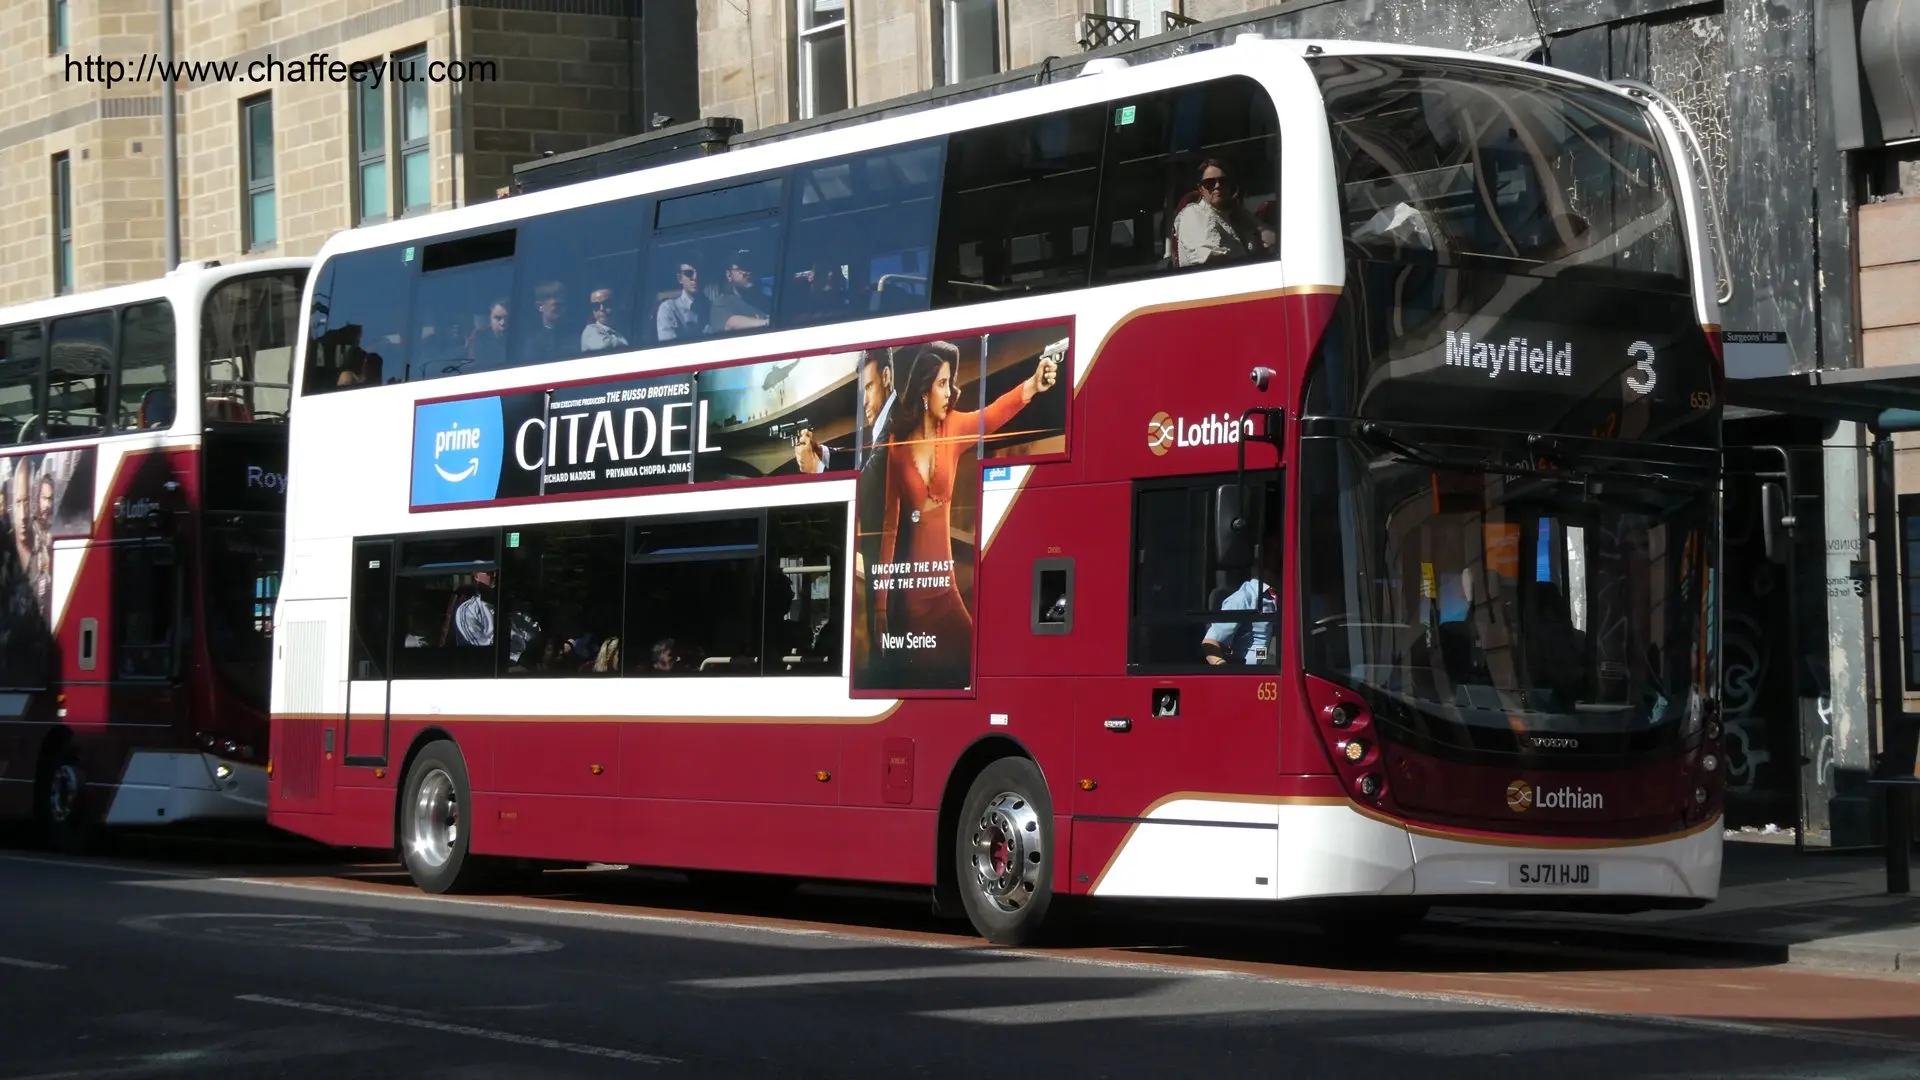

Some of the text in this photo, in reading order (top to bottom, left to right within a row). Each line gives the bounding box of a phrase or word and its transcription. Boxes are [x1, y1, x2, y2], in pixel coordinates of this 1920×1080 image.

[1762, 332, 1778, 342] Hall
[1446, 330, 1572, 379] Mayfield
[1626, 340, 1657, 395] 3
[606, 391, 621, 404] THE
[621, 387, 647, 402] RUSSO
[647, 383, 690, 399] BROTHERS
[1690, 390, 1711, 410] 653
[515, 399, 722, 471] CITADEL
[1177, 412, 1254, 448] Lothian
[435, 422, 481, 460] prime
[543, 462, 692, 484] RICHARD MADDEN PRIYANKA CHOPRA JONAS
[871, 559, 955, 575] UNCOVER THE PAST
[873, 575, 951, 591] SAVE THE FUTURE
[881, 631, 937, 650] New Series
[1257, 682, 1277, 701] 653
[1530, 737, 1579, 749] VOLVO
[1535, 785, 1604, 810] Lothian
[1519, 864, 1590, 884] SJ71 HJD
